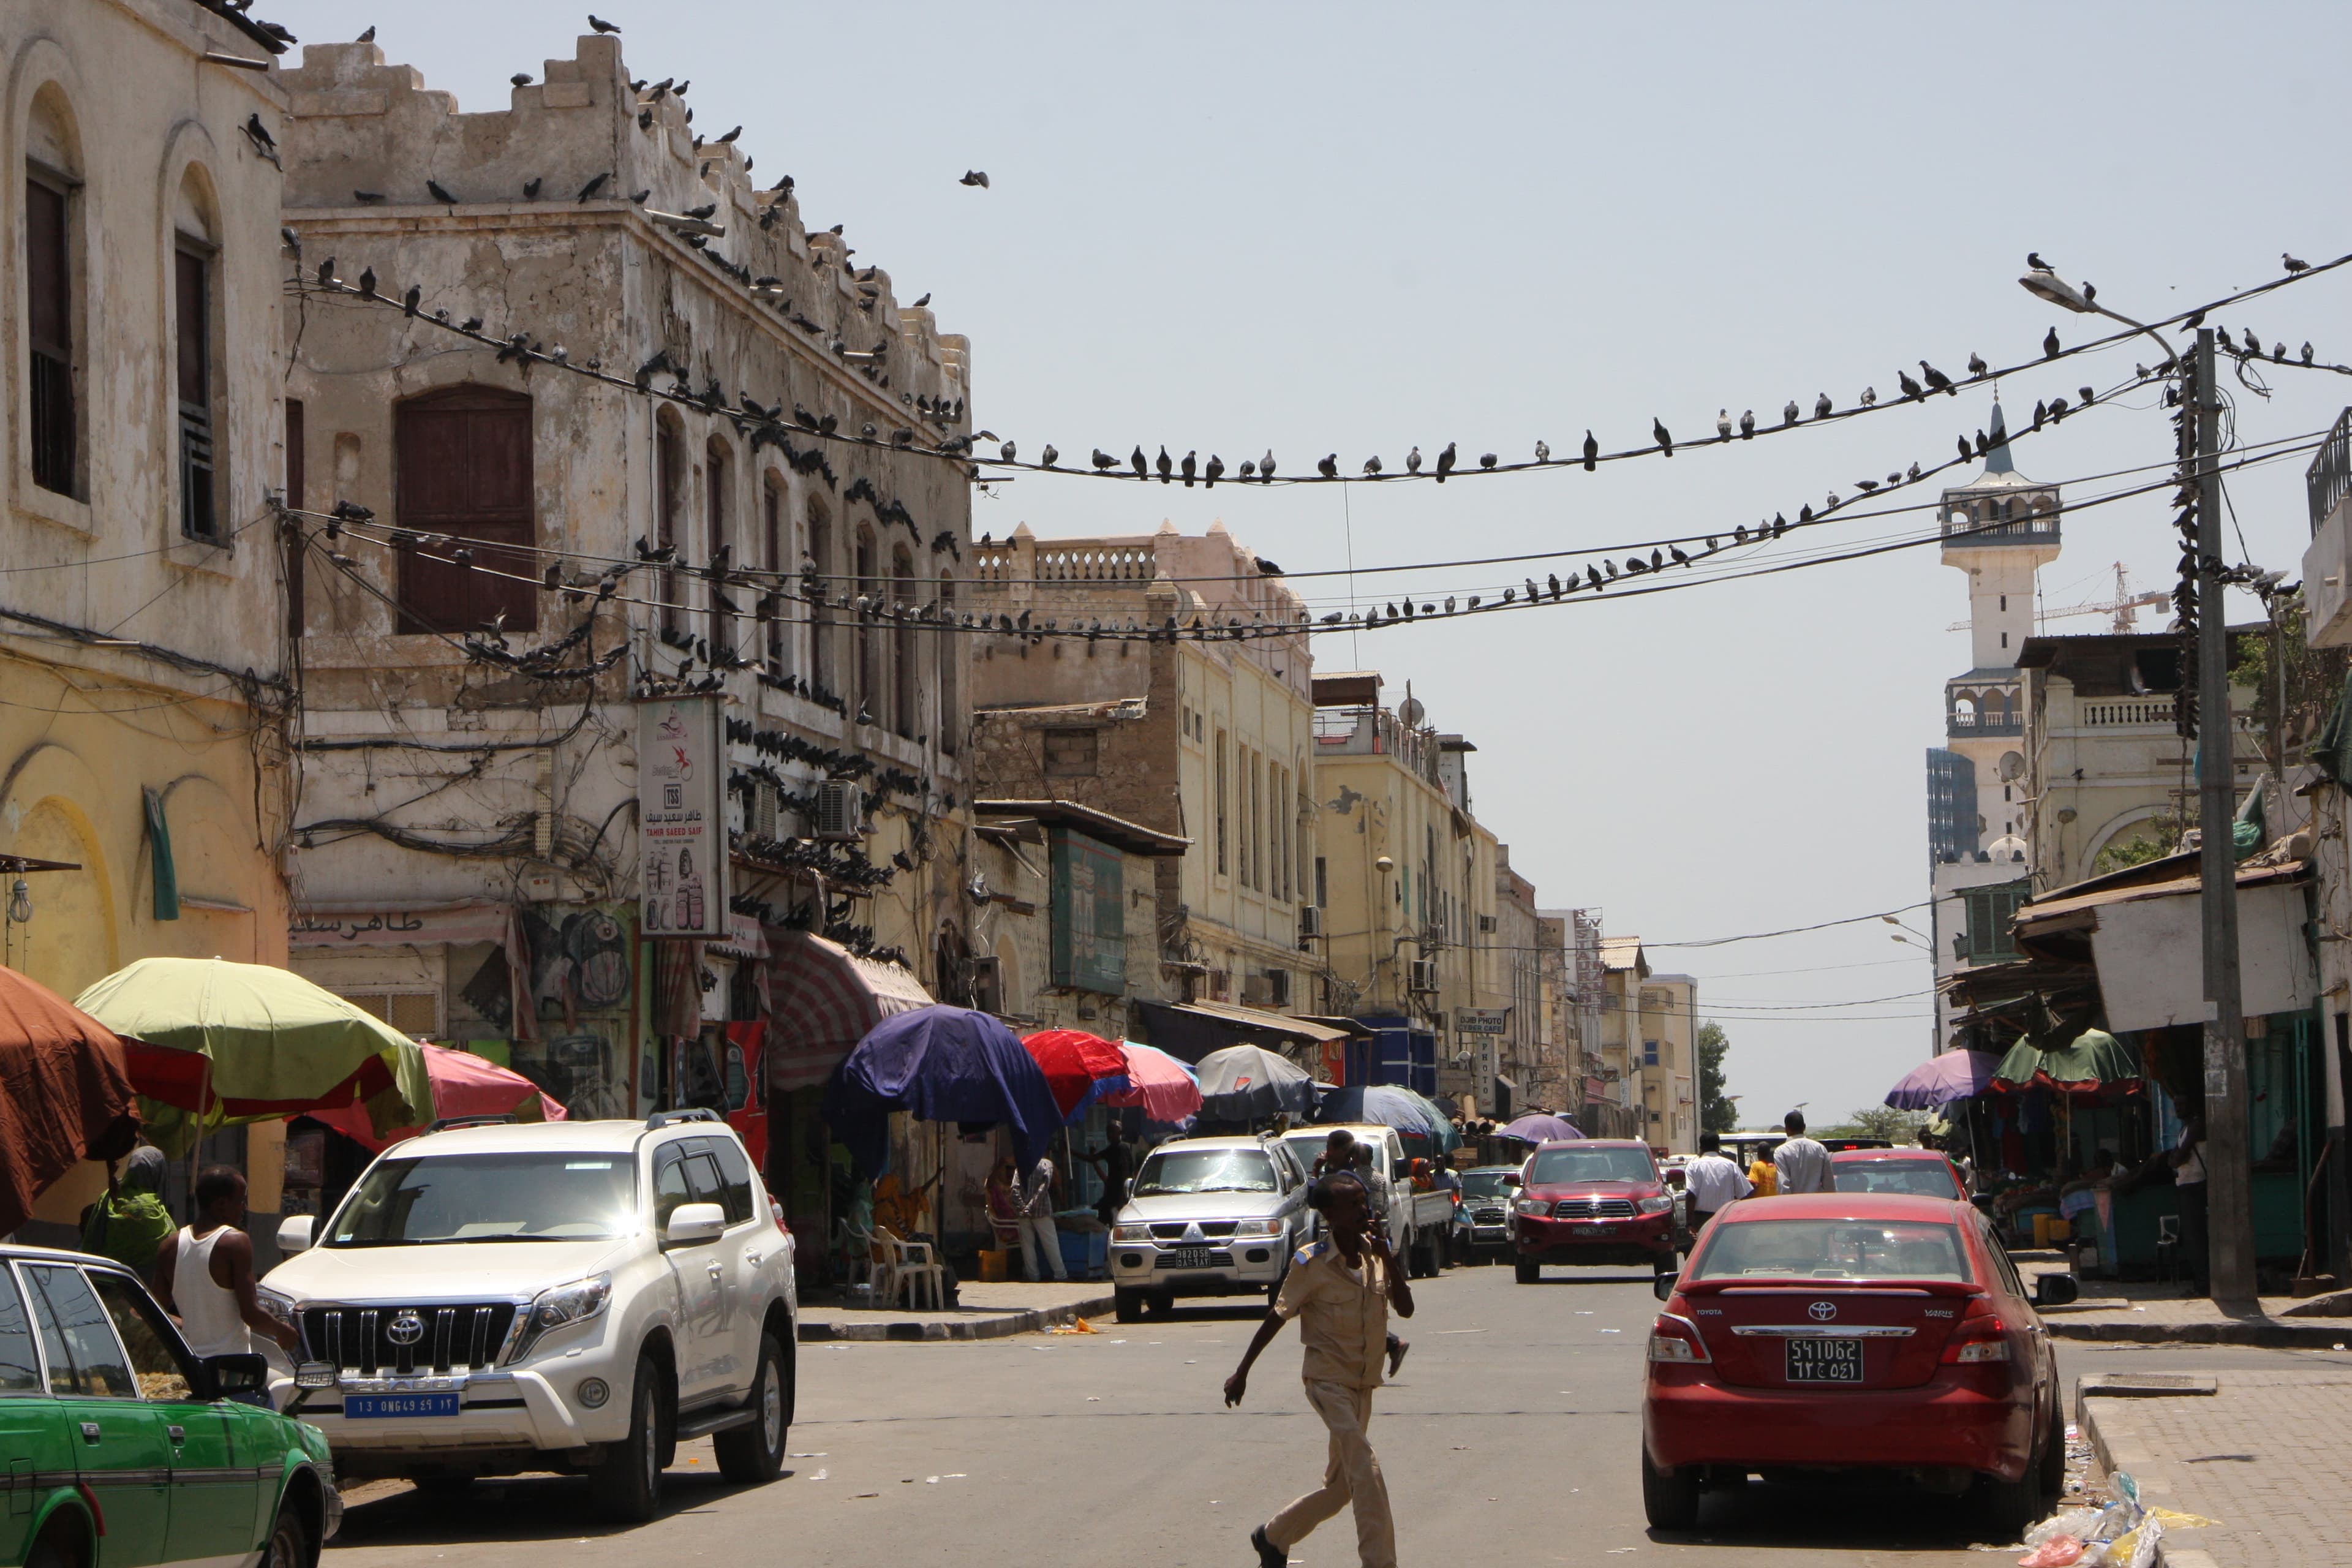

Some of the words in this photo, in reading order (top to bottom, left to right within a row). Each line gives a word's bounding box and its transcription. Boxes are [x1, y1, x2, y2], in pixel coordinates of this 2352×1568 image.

[666, 788, 679, 804] TSS
[646, 809, 662, 826] سيف
[663, 813, 683, 825] سعيد
[685, 810, 701, 824] طاهر
[646, 828, 664, 837] TAHIR
[666, 827, 686, 836] SAEED
[688, 827, 702, 835] SAIF
[340, 911, 424, 940] طاهر
[1575, 909, 1591, 1016] RESTAURANT
[1924, 1309, 1954, 1318] YARIS
